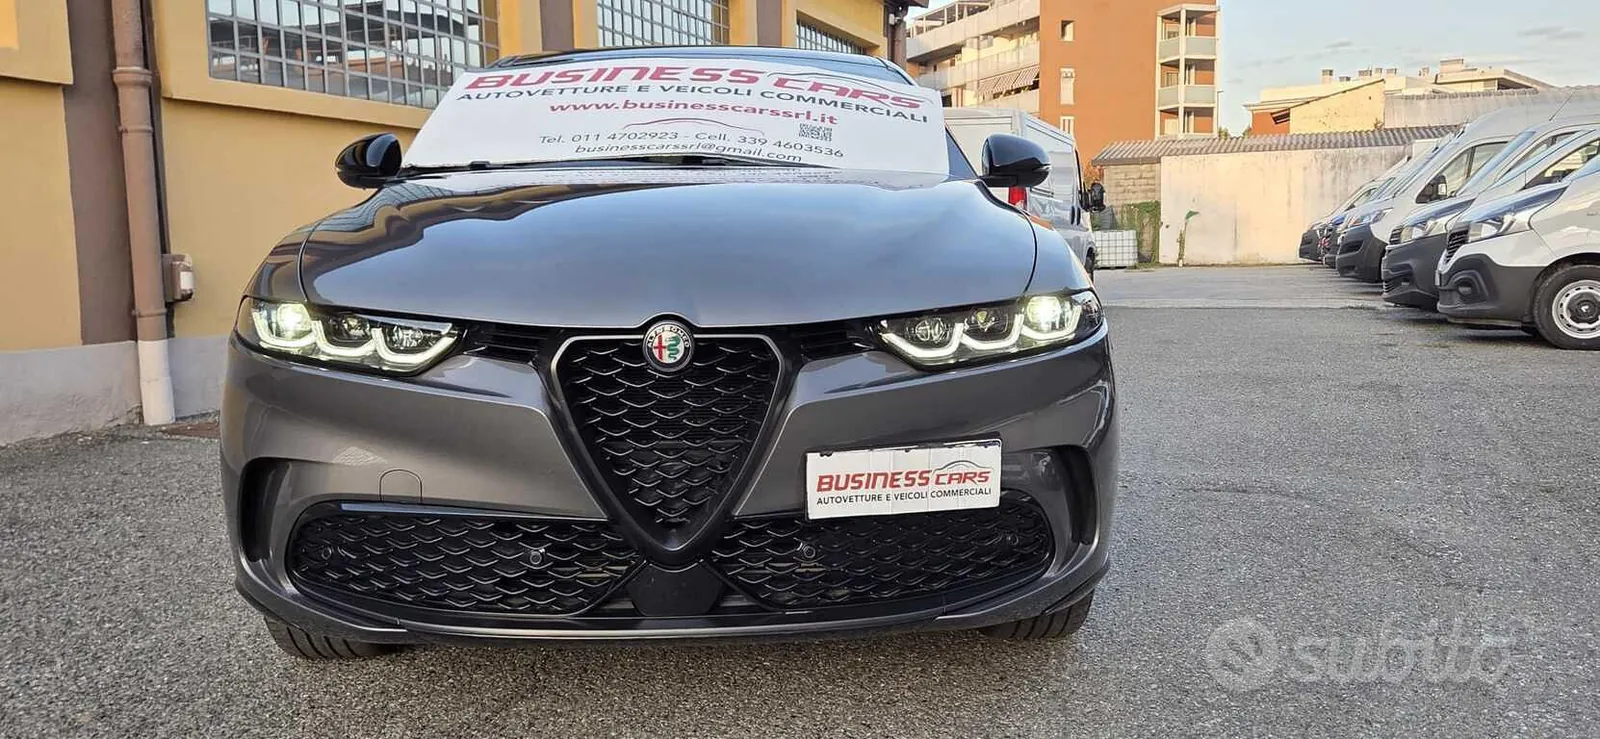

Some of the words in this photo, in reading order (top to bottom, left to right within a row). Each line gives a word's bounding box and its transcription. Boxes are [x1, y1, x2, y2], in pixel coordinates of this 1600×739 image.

[465, 67, 766, 89] BUSINESS
[772, 77, 927, 109] CARS
[457, 85, 629, 101] AUTOVETTURE
[637, 85, 650, 93] E
[660, 84, 752, 96] VEICOLI
[760, 91, 928, 123] COMMERCIALI
[550, 100, 838, 125] www.businesscarssrl.it
[539, 134, 565, 144] Tel.
[571, 133, 600, 143] 011
[607, 132, 678, 142] 4702923
[695, 132, 731, 142] Cell.
[738, 135, 767, 146] 339
[773, 140, 845, 158] 4603536
[575, 142, 802, 162] businesscarssrl@gmail.com
[816, 470, 932, 493] BUSINESS
[935, 471, 991, 486] CARS
[816, 494, 883, 505] AUTOVETTURE
[894, 492, 929, 501] VEICOLI
[930, 487, 992, 499] COMMERCIALI
